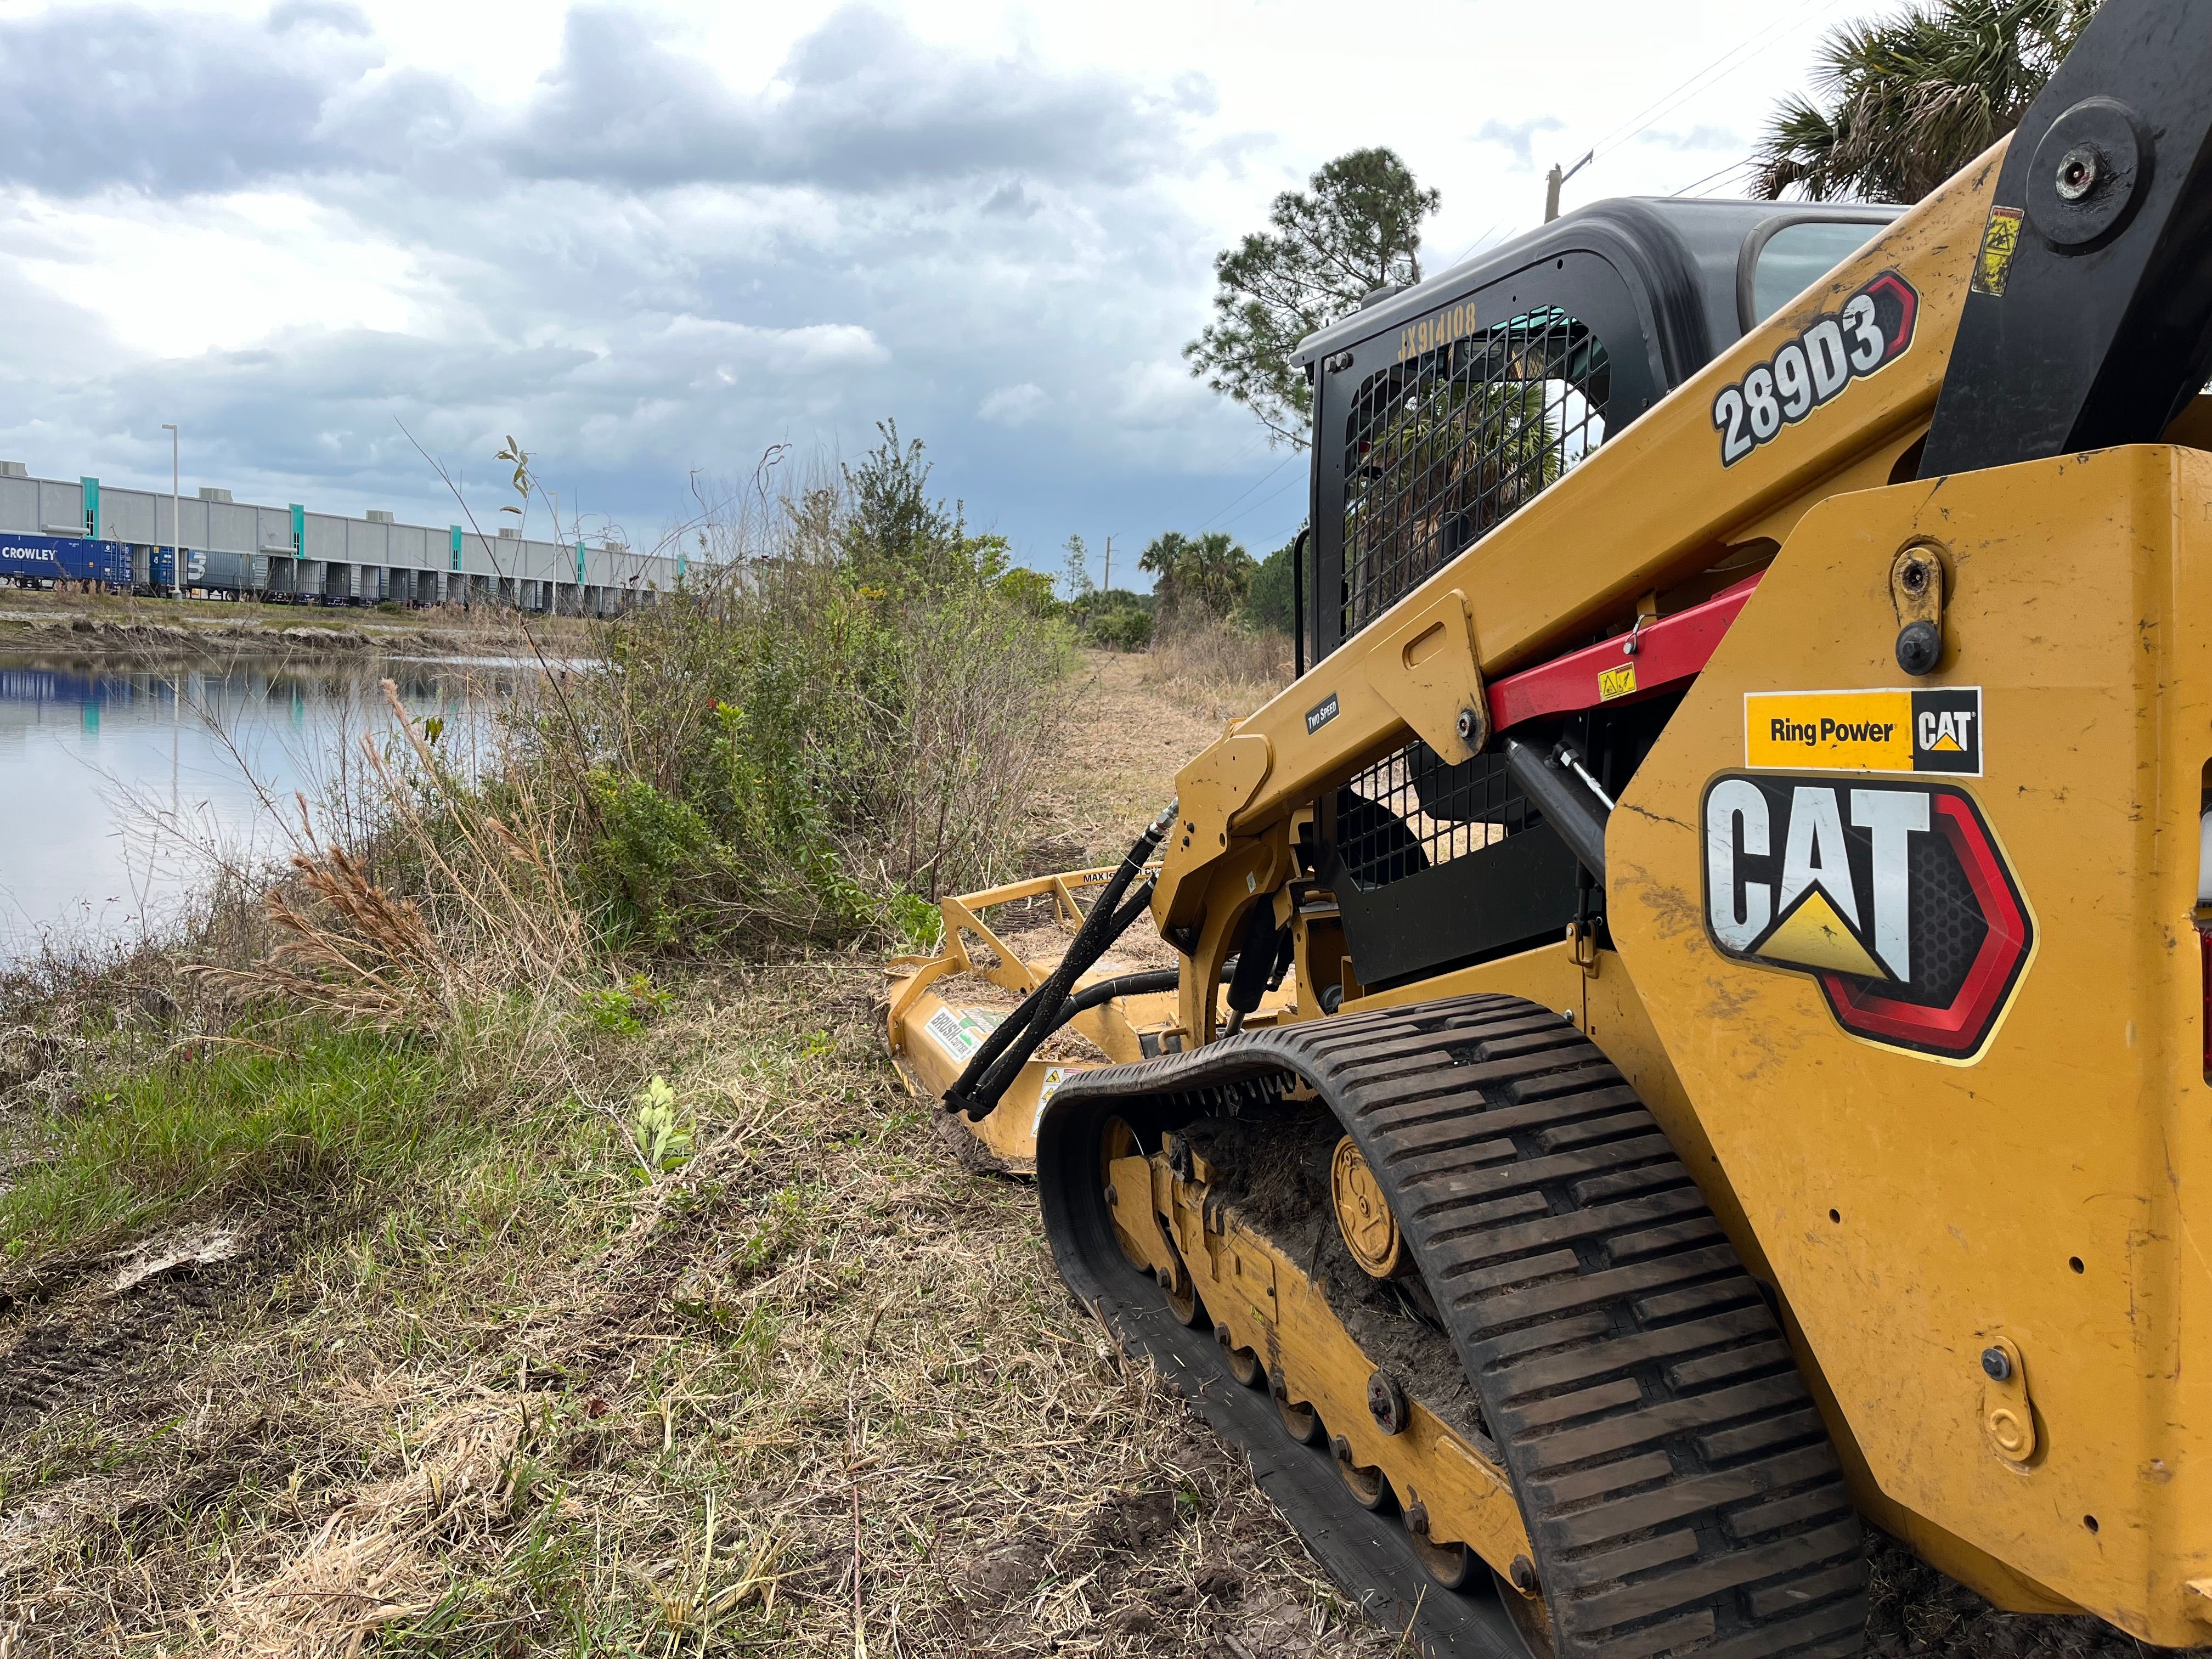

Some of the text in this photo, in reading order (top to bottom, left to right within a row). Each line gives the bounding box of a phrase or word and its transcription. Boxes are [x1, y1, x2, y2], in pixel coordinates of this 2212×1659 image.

[1398, 302, 1475, 362] JX914108
[1715, 295, 1884, 461] 289D3
[2, 547, 55, 560] CROWLEY
[1308, 701, 1336, 729] TWO SPEED
[1771, 718, 1894, 746] Ring Power
[1918, 712, 1971, 751] CAT
[1084, 873, 1104, 883] MAX
[1707, 780, 1930, 983] CAT
[931, 1013, 962, 1042] BRUSH
[952, 1037, 968, 1054] CUTTER
